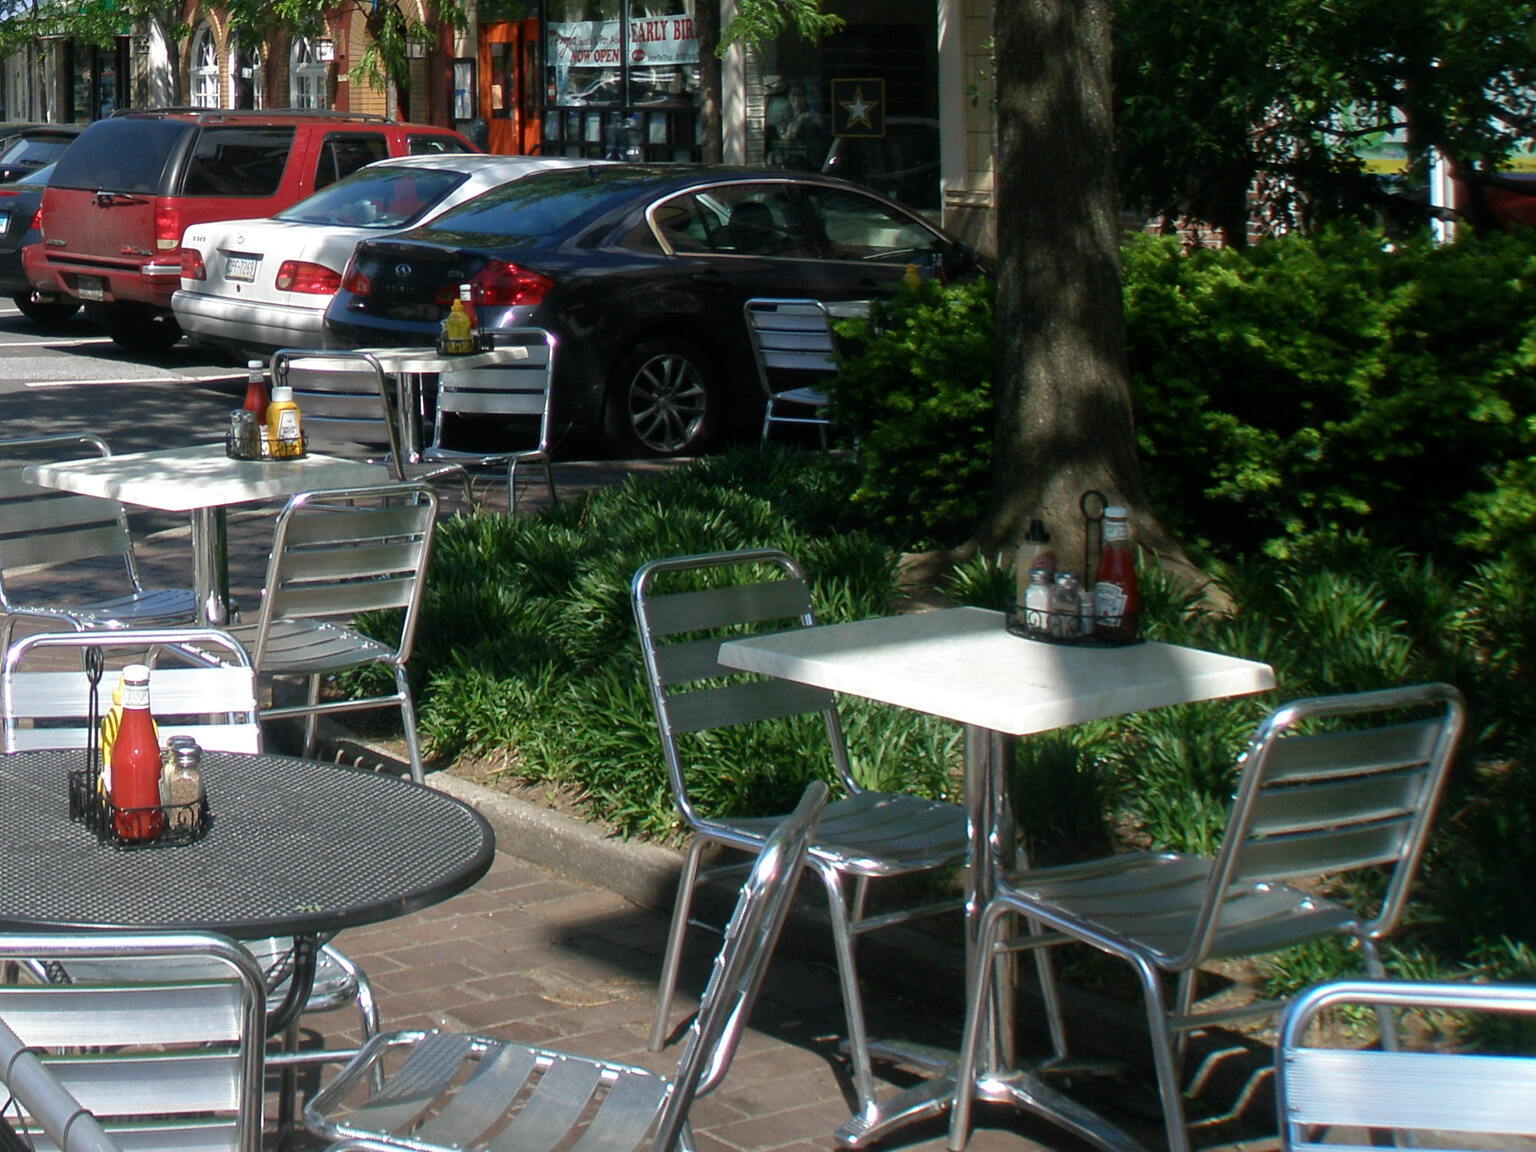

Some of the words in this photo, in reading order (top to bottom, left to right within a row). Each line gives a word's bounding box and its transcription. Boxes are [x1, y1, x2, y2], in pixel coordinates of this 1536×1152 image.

[630, 19, 668, 43] EARLY
[570, 50, 592, 63] NOW
[594, 48, 620, 63] OPEN
